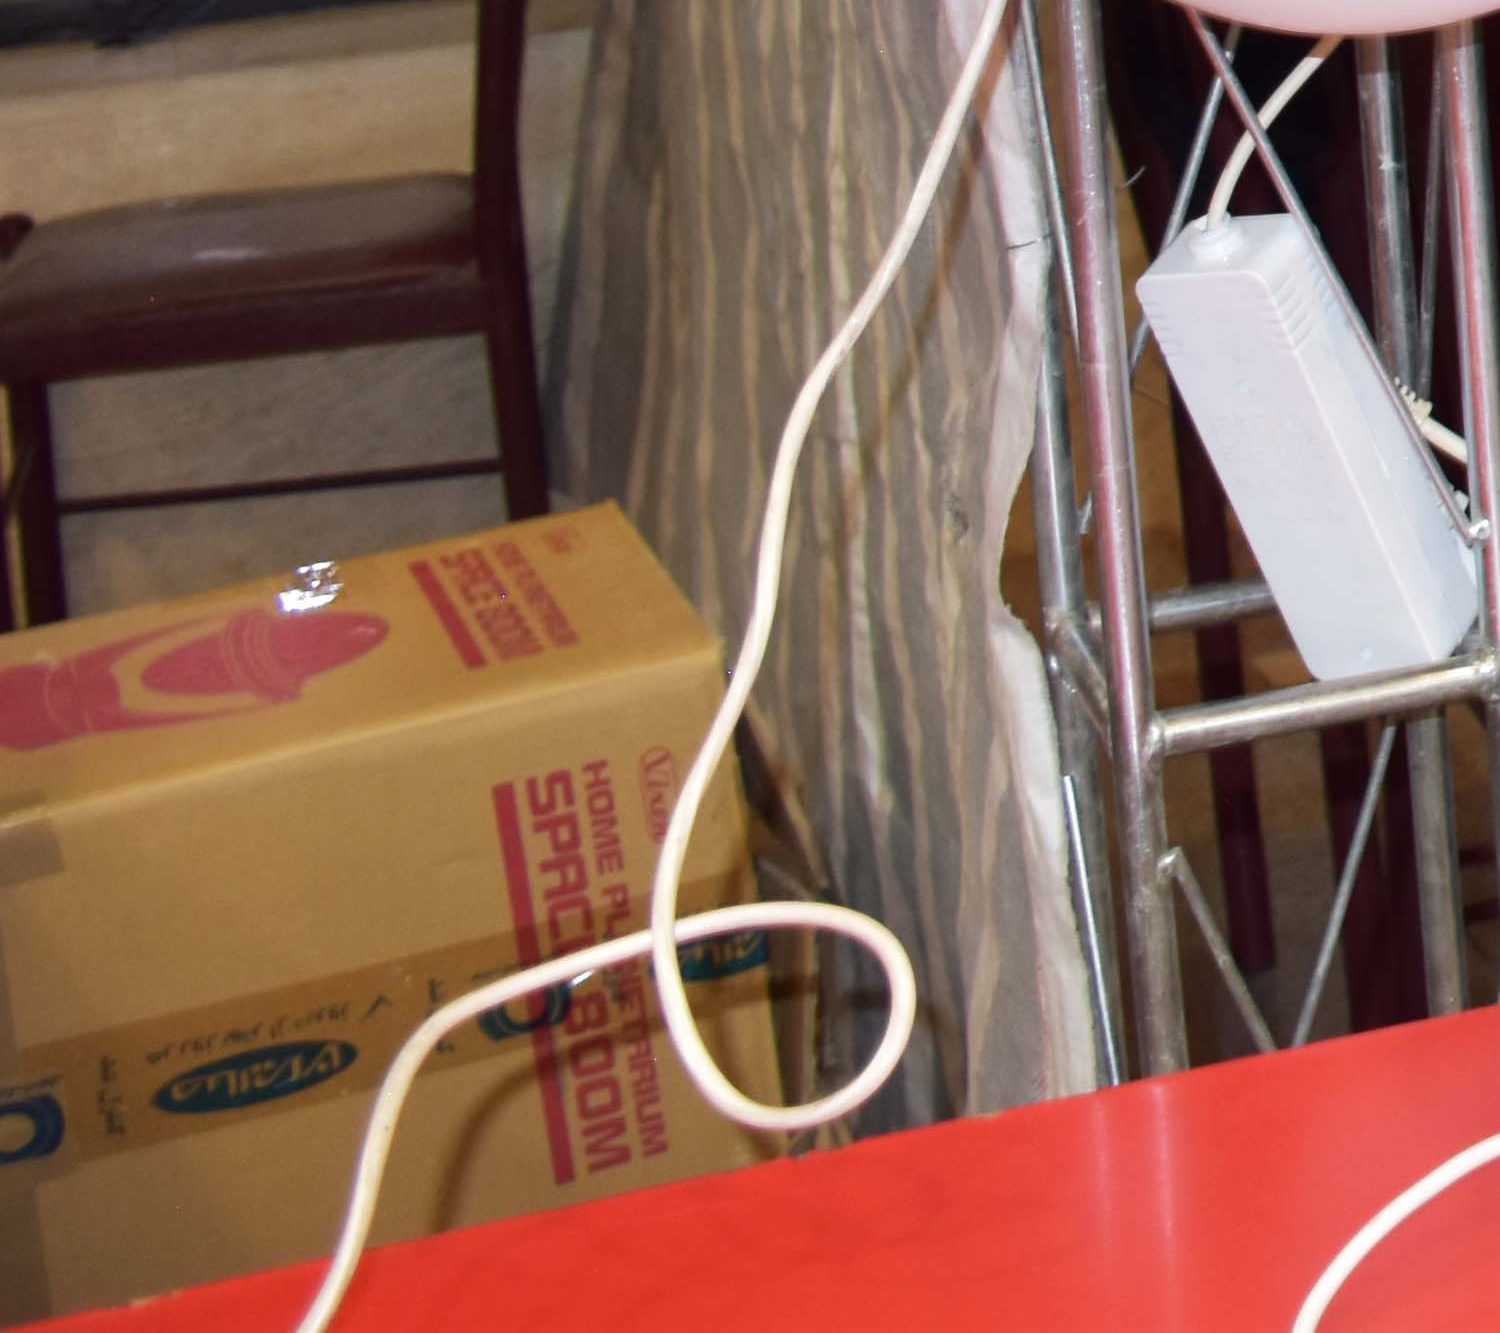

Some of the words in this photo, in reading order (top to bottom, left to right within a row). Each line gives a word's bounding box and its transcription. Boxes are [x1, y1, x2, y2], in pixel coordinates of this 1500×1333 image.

[581, 759, 625, 875] HOME
[526, 769, 598, 963] SPAC
[563, 988, 632, 1174] 800M
[601, 882, 669, 1158] PLNETARIUM
